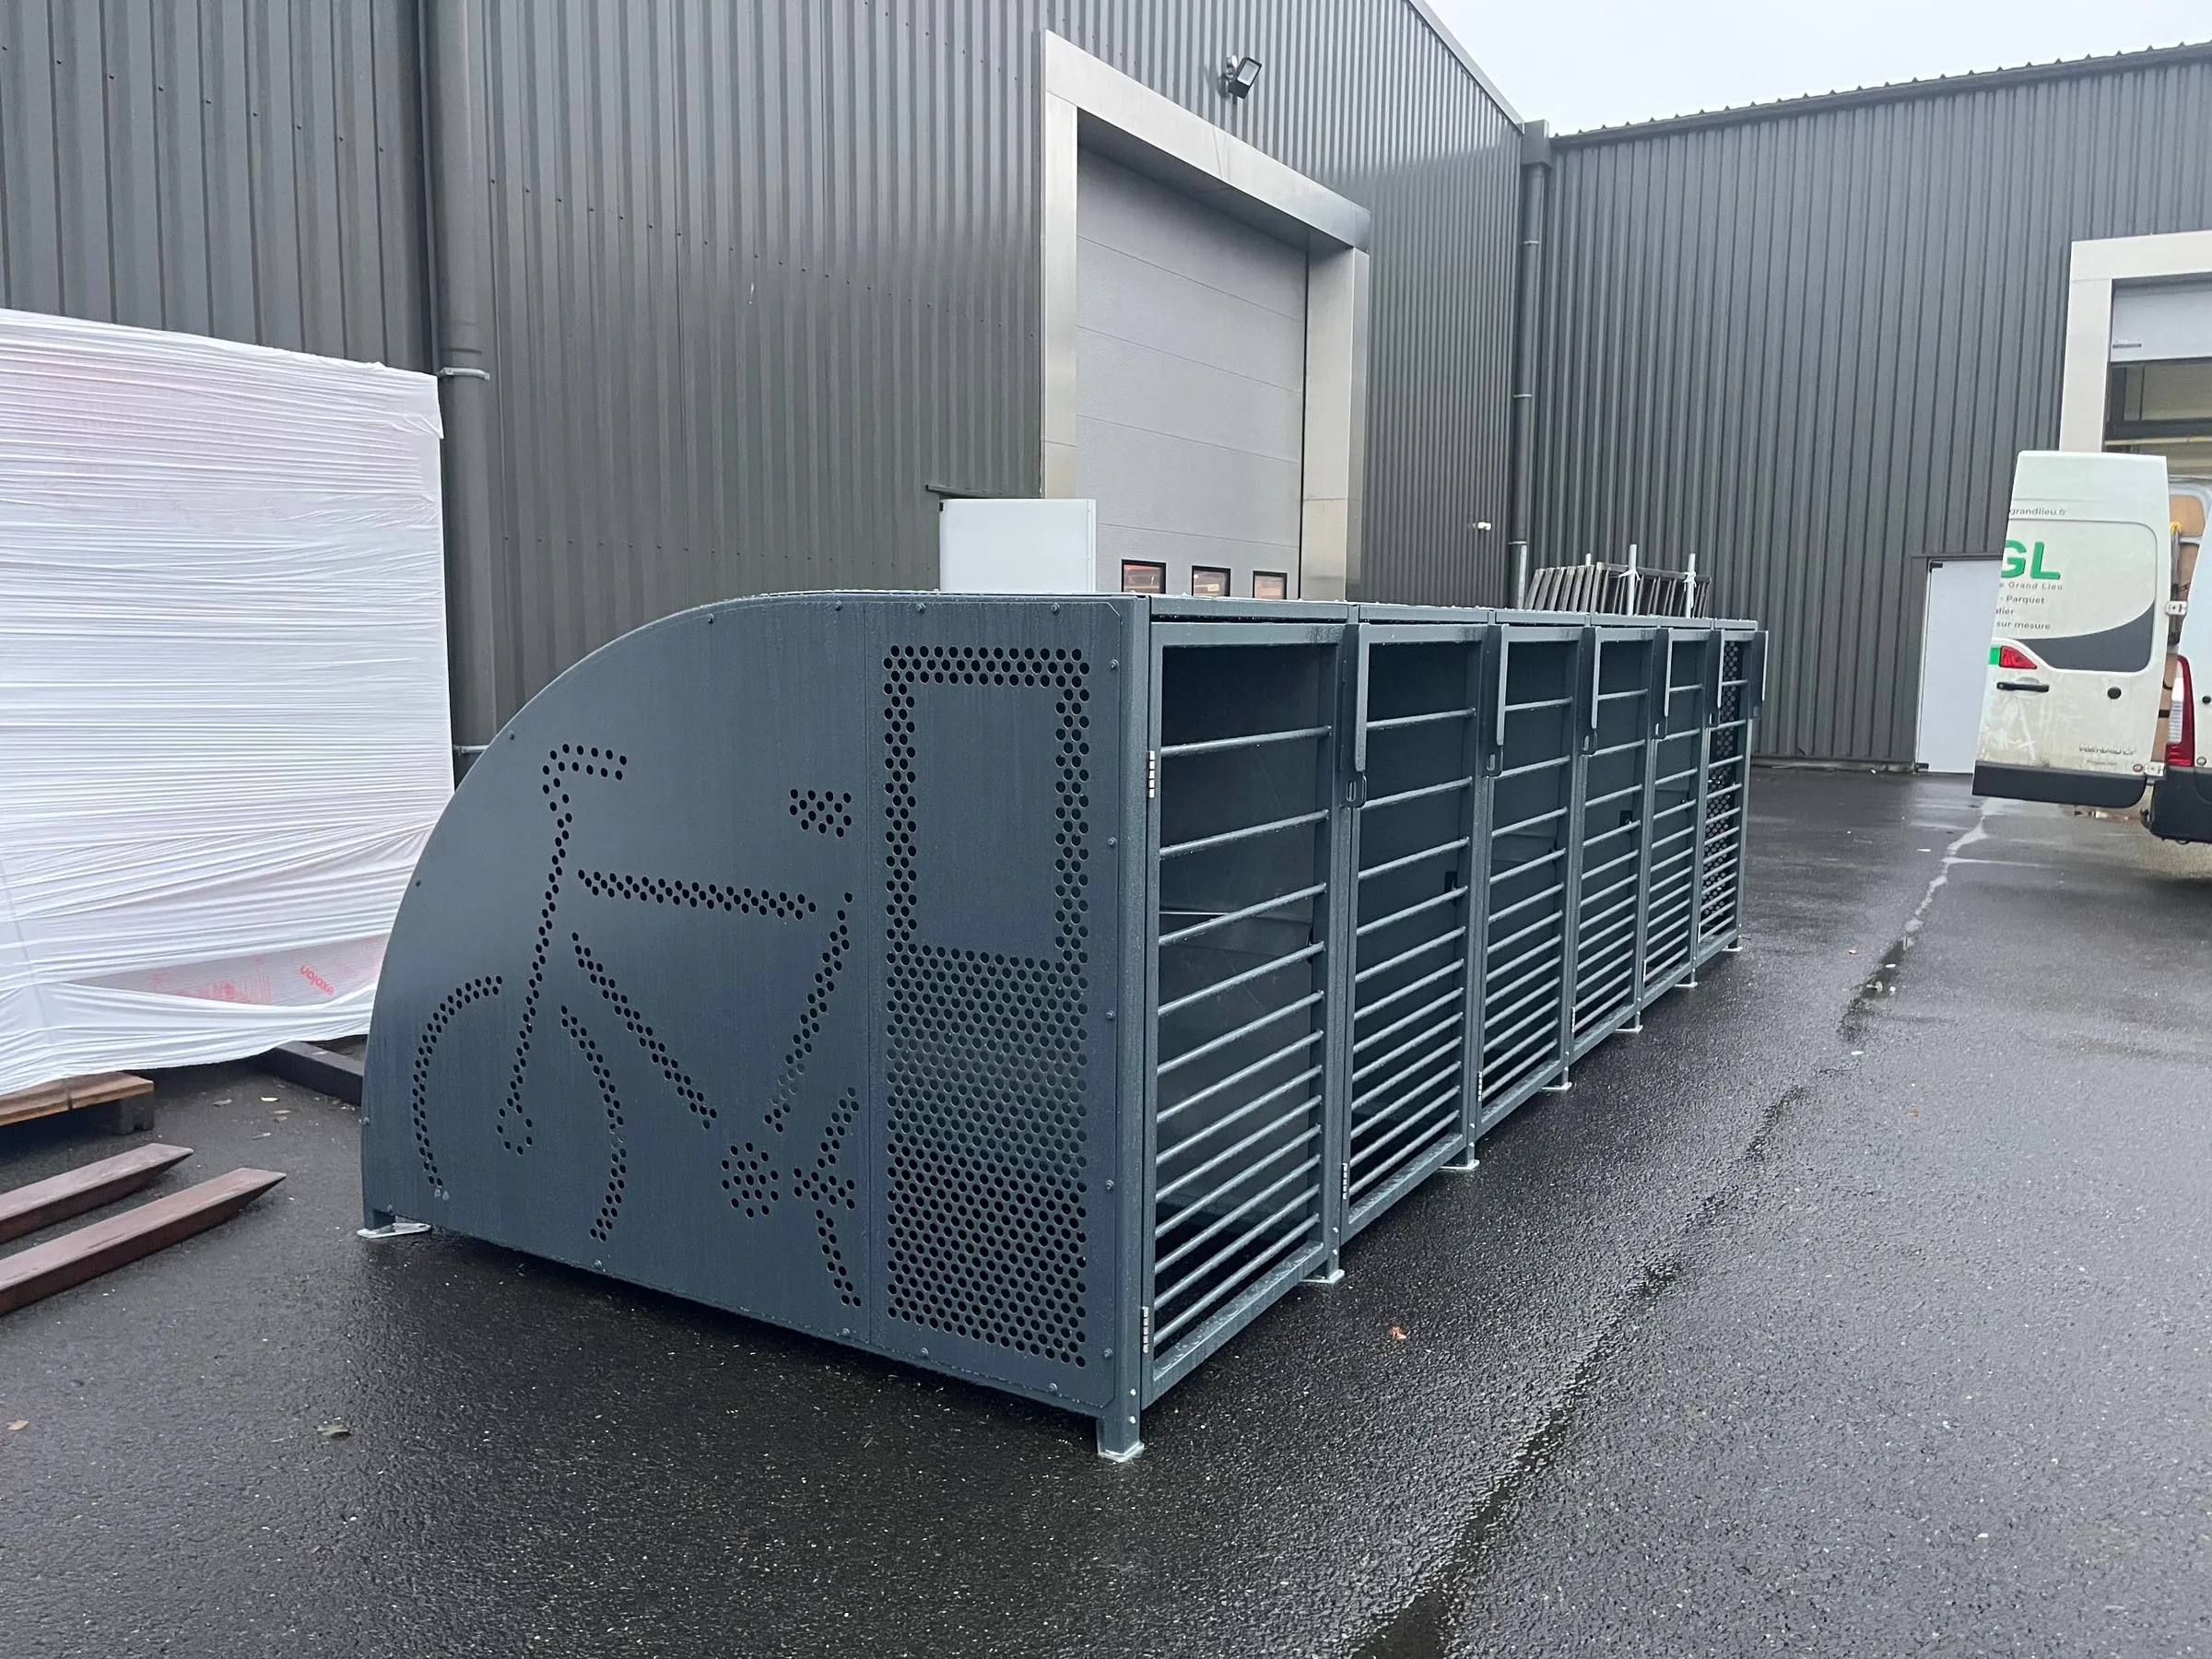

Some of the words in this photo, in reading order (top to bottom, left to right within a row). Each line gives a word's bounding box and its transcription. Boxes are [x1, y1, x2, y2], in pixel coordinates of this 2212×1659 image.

[2000, 540, 2061, 580] GL
[2008, 581, 2039, 590] Grand
[2041, 582, 2064, 591] Lieu
[2006, 594, 2045, 605] Parquet
[2014, 621, 2052, 630] mesure
[299, 964, 335, 996] exolon
